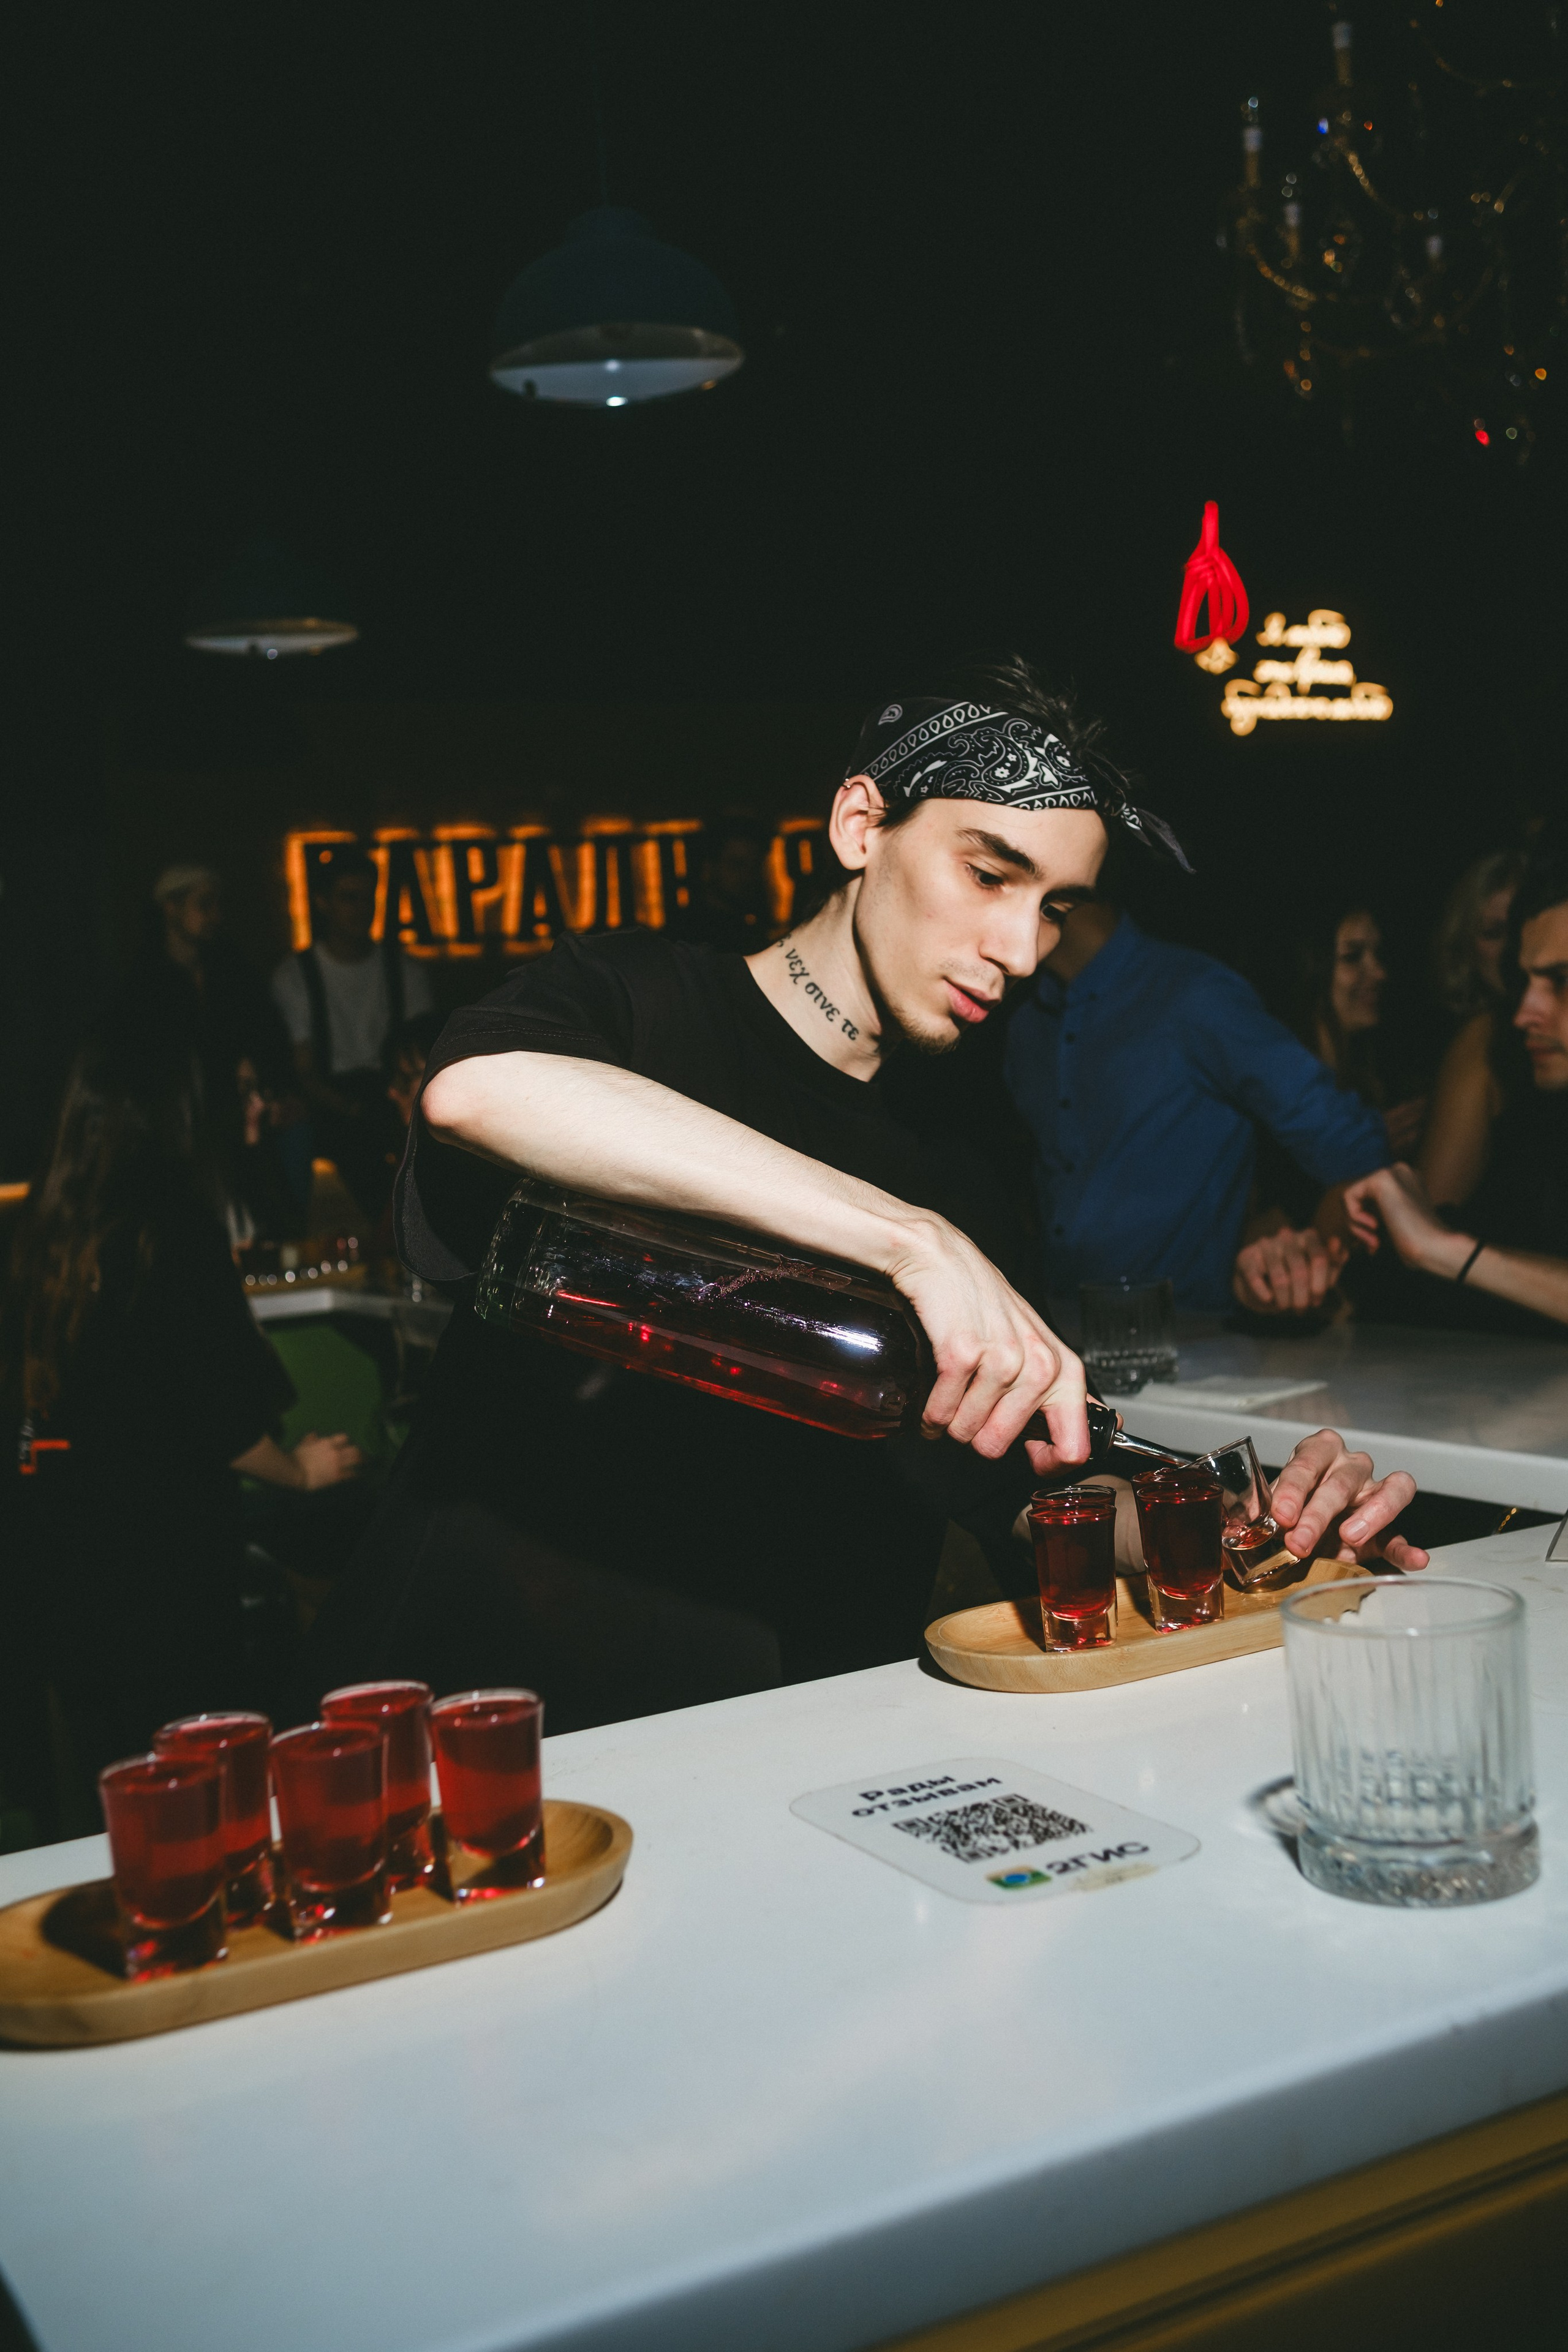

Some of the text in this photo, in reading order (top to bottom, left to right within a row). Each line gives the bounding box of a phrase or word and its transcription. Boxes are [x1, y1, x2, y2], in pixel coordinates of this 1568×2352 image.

[852, 1777, 1003, 1817] отзывам
[859, 1776, 956, 1801] Рады
[1046, 1842, 1150, 1875] 2ГИС
